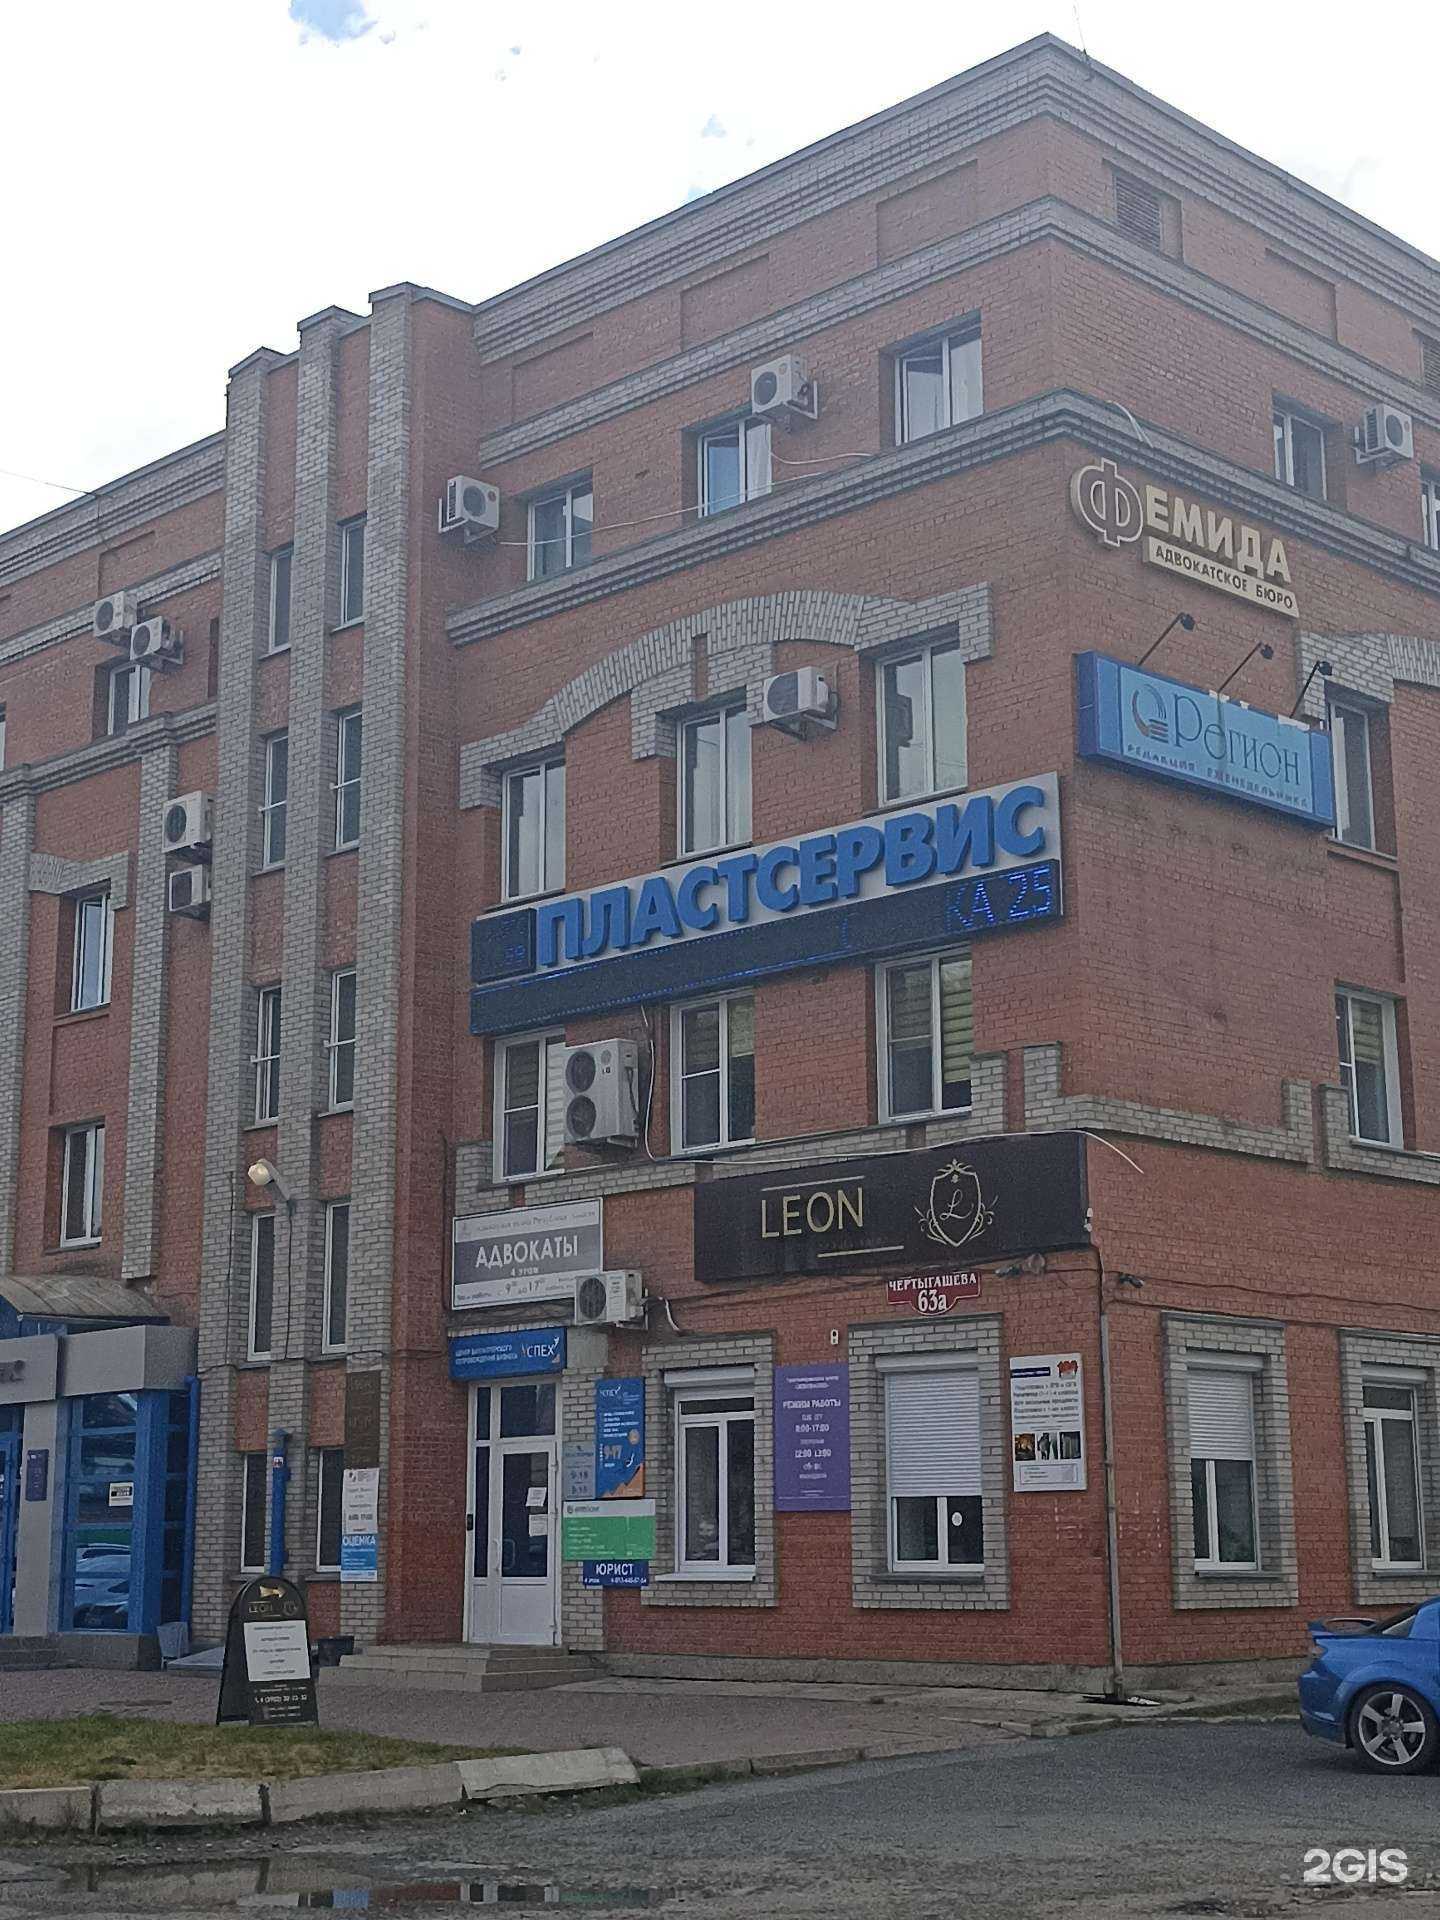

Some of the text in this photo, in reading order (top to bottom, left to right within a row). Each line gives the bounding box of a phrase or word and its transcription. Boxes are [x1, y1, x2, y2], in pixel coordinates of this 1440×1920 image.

[1071, 457, 1292, 584] ФЕМИДА
[1155, 545, 1294, 610] АДВОКАТСКОЕ БЮРО
[536, 784, 1047, 968] ПЛАСТСЕРВИС
[761, 1186, 864, 1239] LEON
[475, 1234, 579, 1270] АДВОКАТЫ
[888, 1273, 977, 1292] ЧЕРТЫГАШЕВА
[918, 1289, 948, 1313] 63а
[342, 1536, 376, 1547] ОЦЕНКА
[595, 1563, 634, 1576] ЮРИСТ
